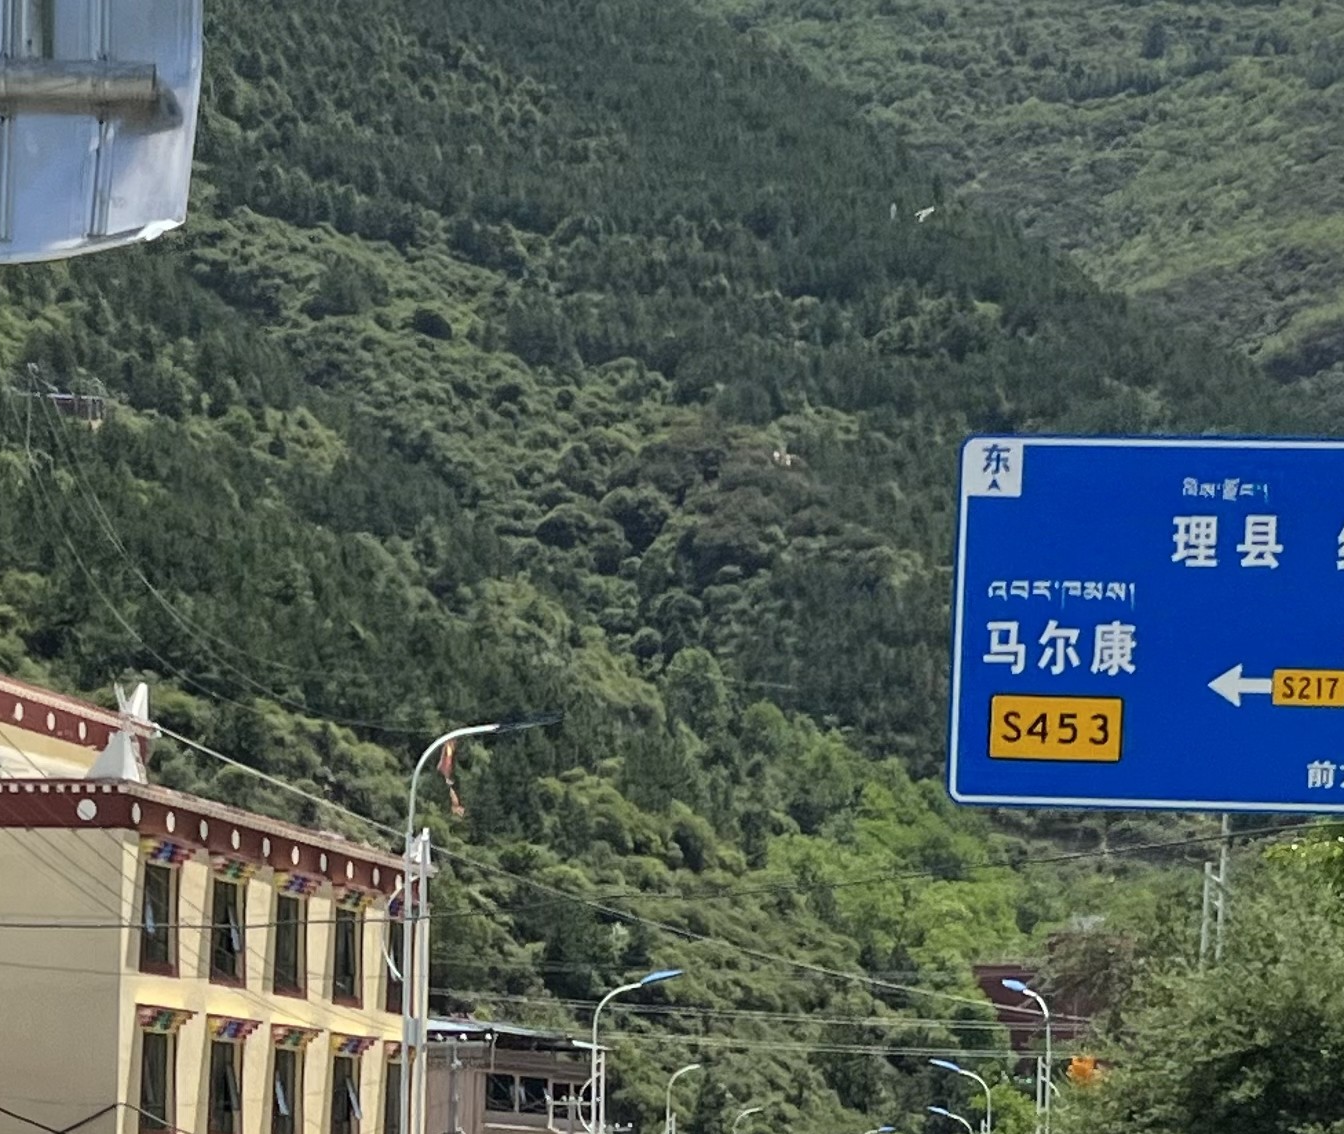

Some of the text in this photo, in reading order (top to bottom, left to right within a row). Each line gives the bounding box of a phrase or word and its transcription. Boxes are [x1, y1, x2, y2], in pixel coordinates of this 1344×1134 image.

[981, 443, 1012, 476] 东
[1171, 515, 1284, 569] 理县
[982, 619, 1137, 676] 马尔康
[1281, 675, 1340, 700] S217
[1000, 710, 1110, 746] S453
